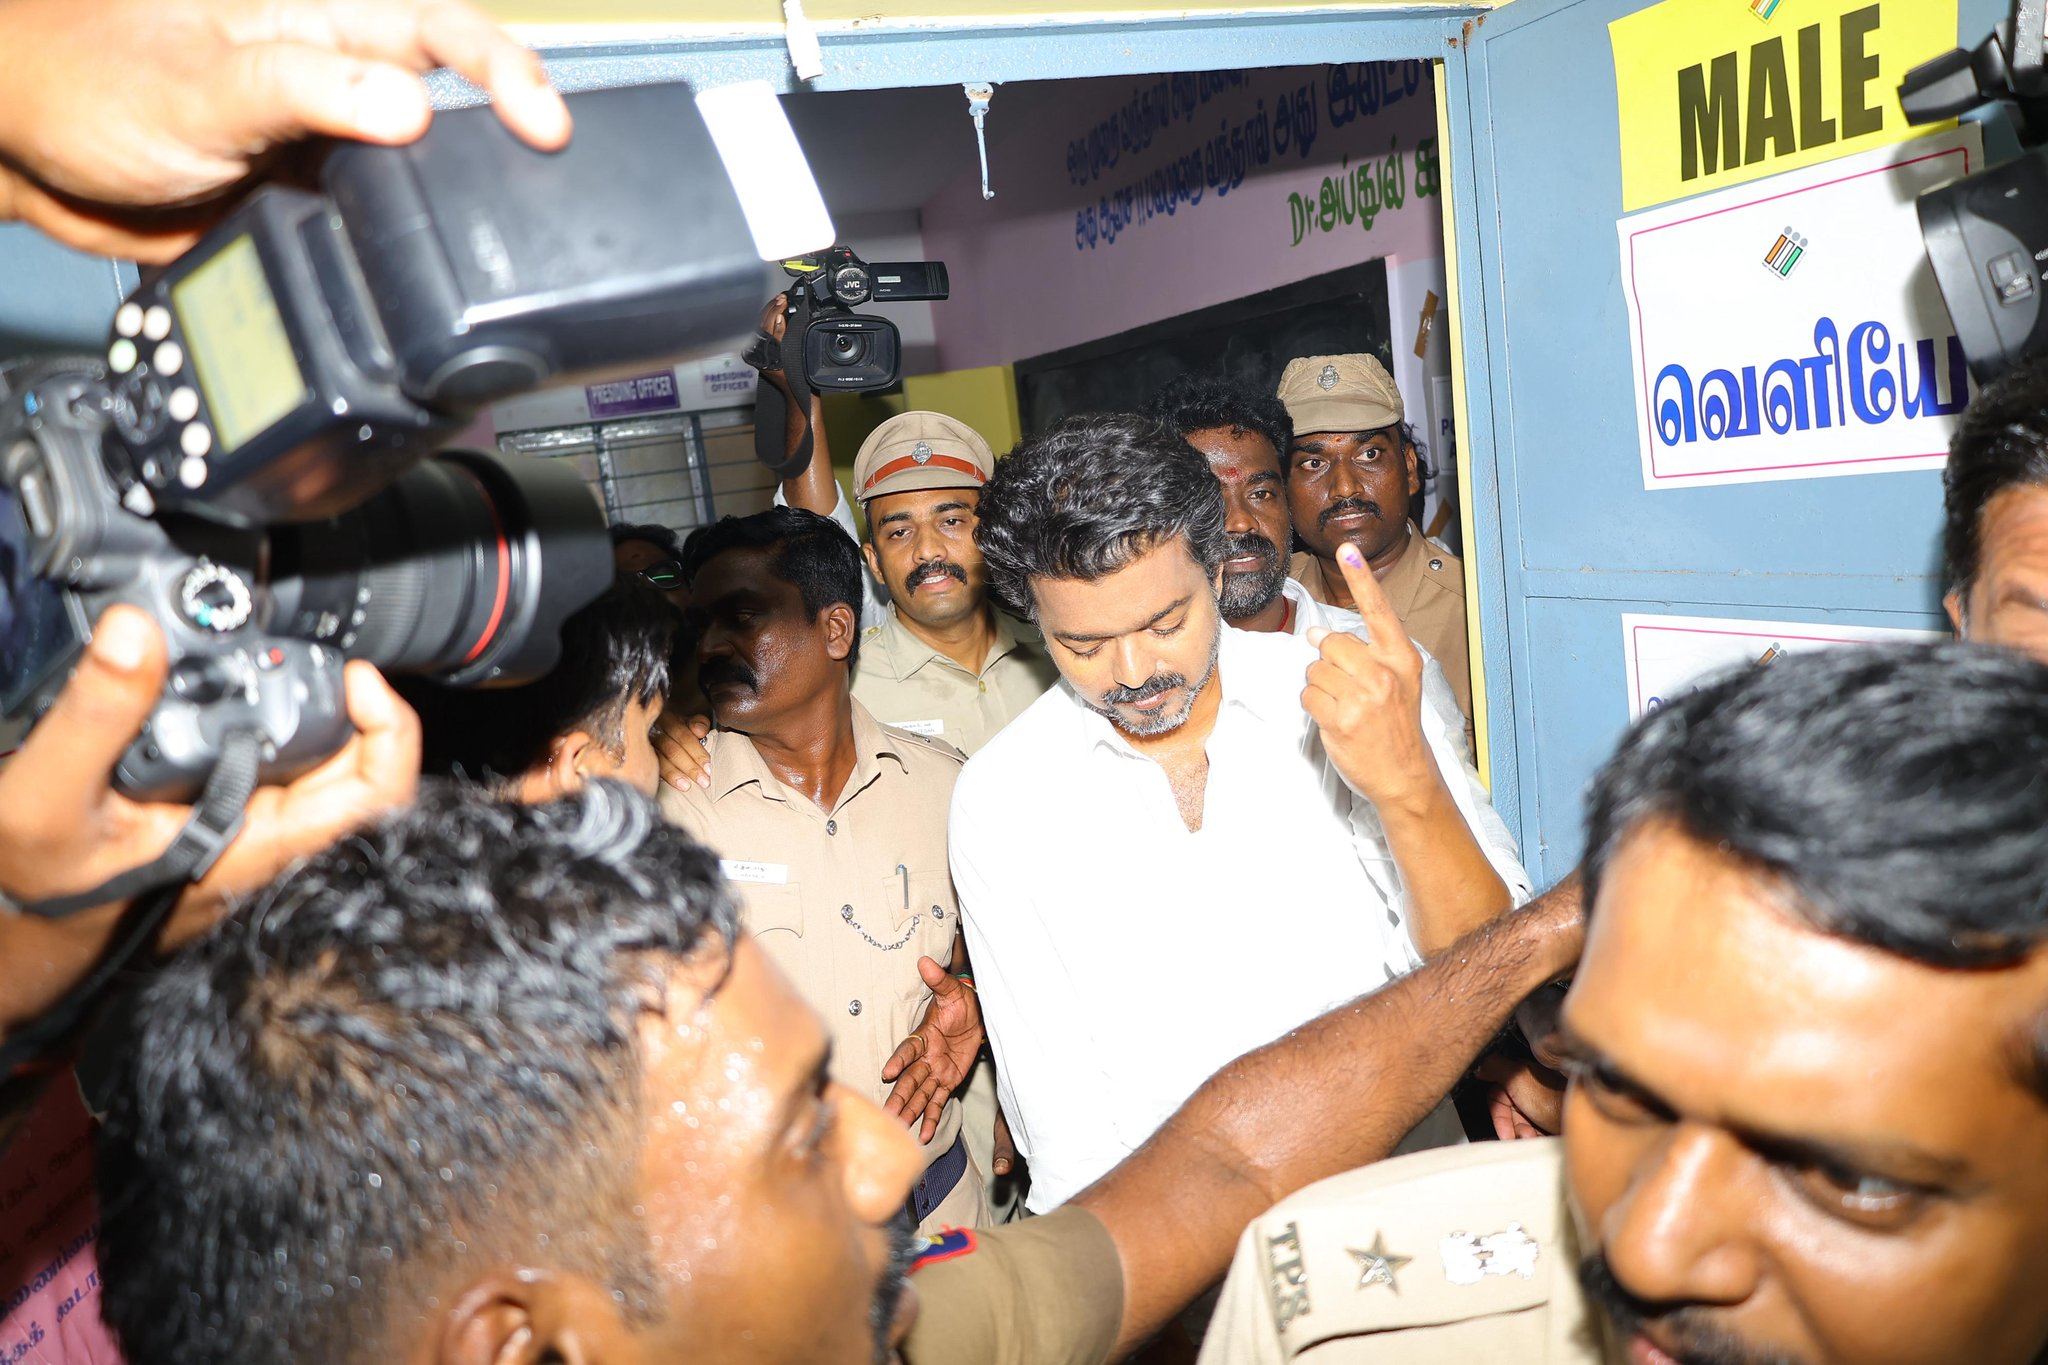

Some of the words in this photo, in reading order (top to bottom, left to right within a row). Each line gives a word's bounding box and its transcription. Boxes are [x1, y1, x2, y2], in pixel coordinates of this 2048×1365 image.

[1678, 3, 1883, 182] MALE
[1205, 99, 1270, 197] வந்தால்
[1273, 82, 1318, 159] அது
[844, 280, 861, 289] JVC
[591, 380, 636, 405] PRESIDING
[636, 375, 674, 400] OFFICER
[704, 370, 754, 383] PRESIDING
[711, 381, 751, 393] OFFICER
[1267, 1220, 1312, 1333] TPS
